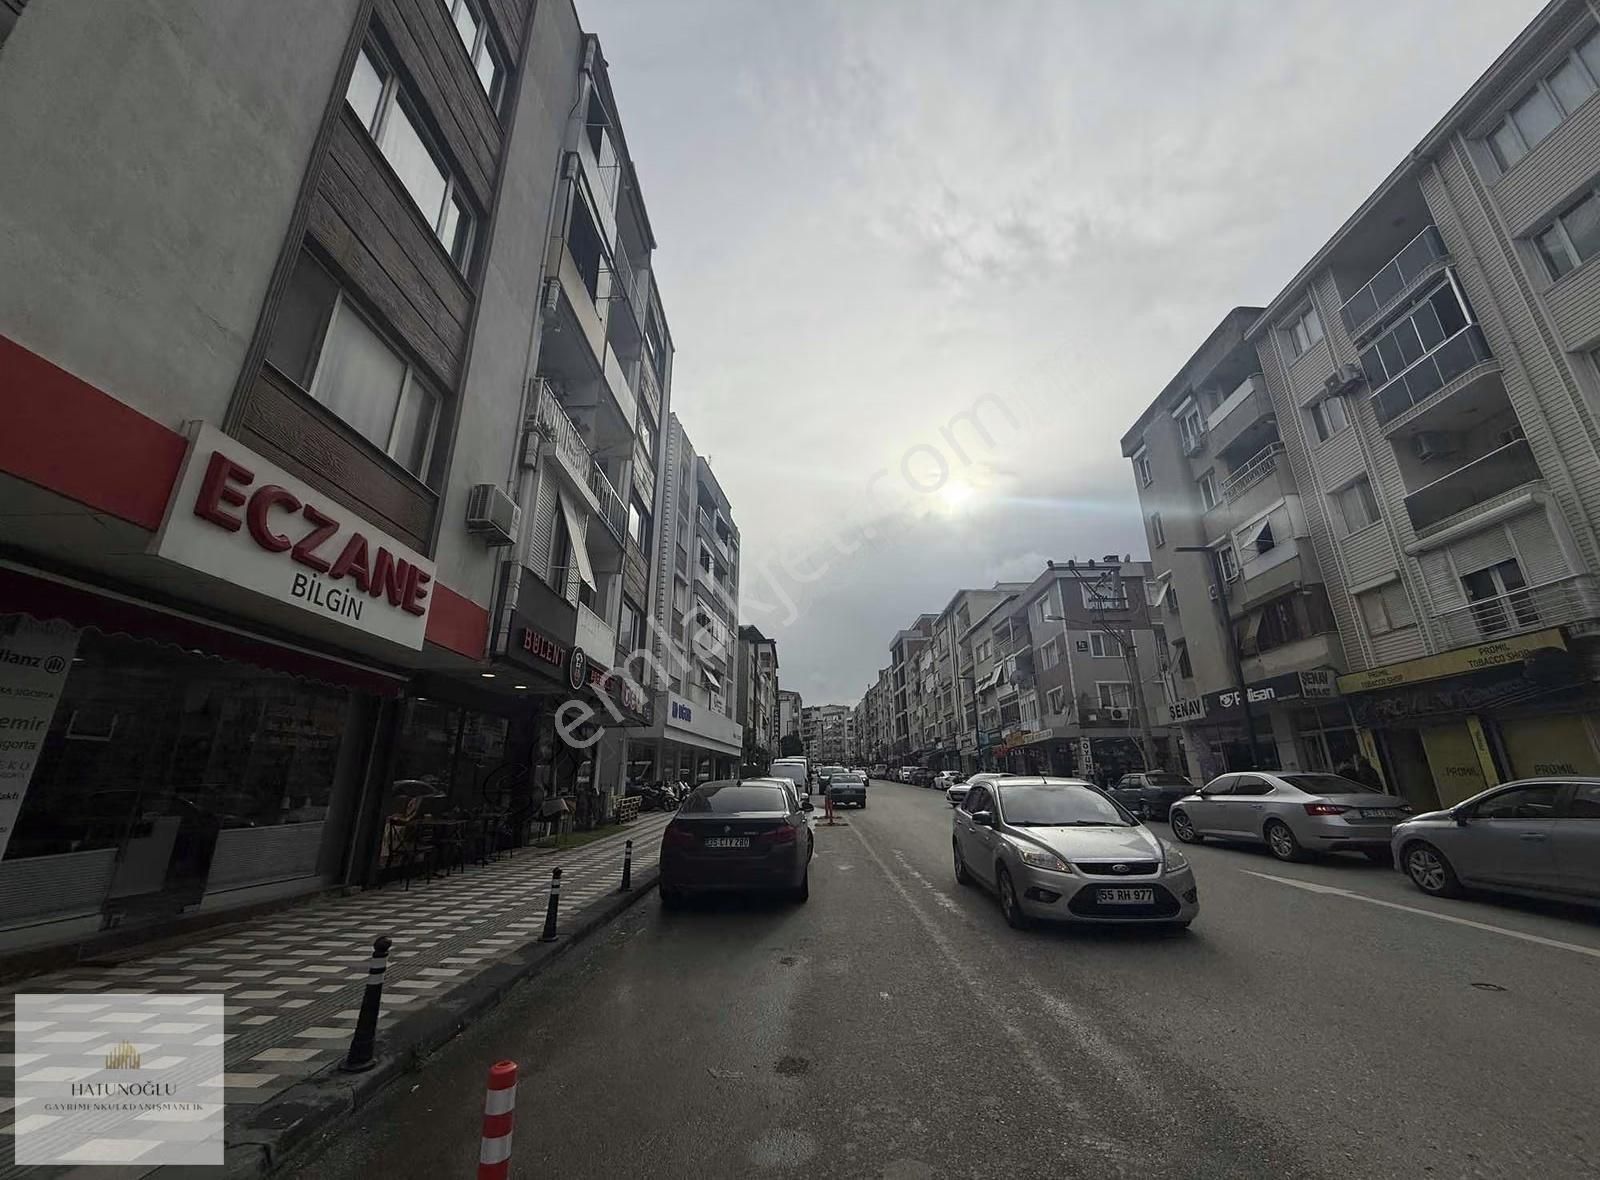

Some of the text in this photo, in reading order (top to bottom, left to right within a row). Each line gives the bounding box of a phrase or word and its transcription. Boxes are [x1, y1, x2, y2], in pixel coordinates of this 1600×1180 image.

[194, 451, 432, 616] ECZANE
[291, 573, 364, 621] BİLGİN
[1234, 686, 1275, 705] plisan
[1100, 889, 1153, 901] 55 RH 977
